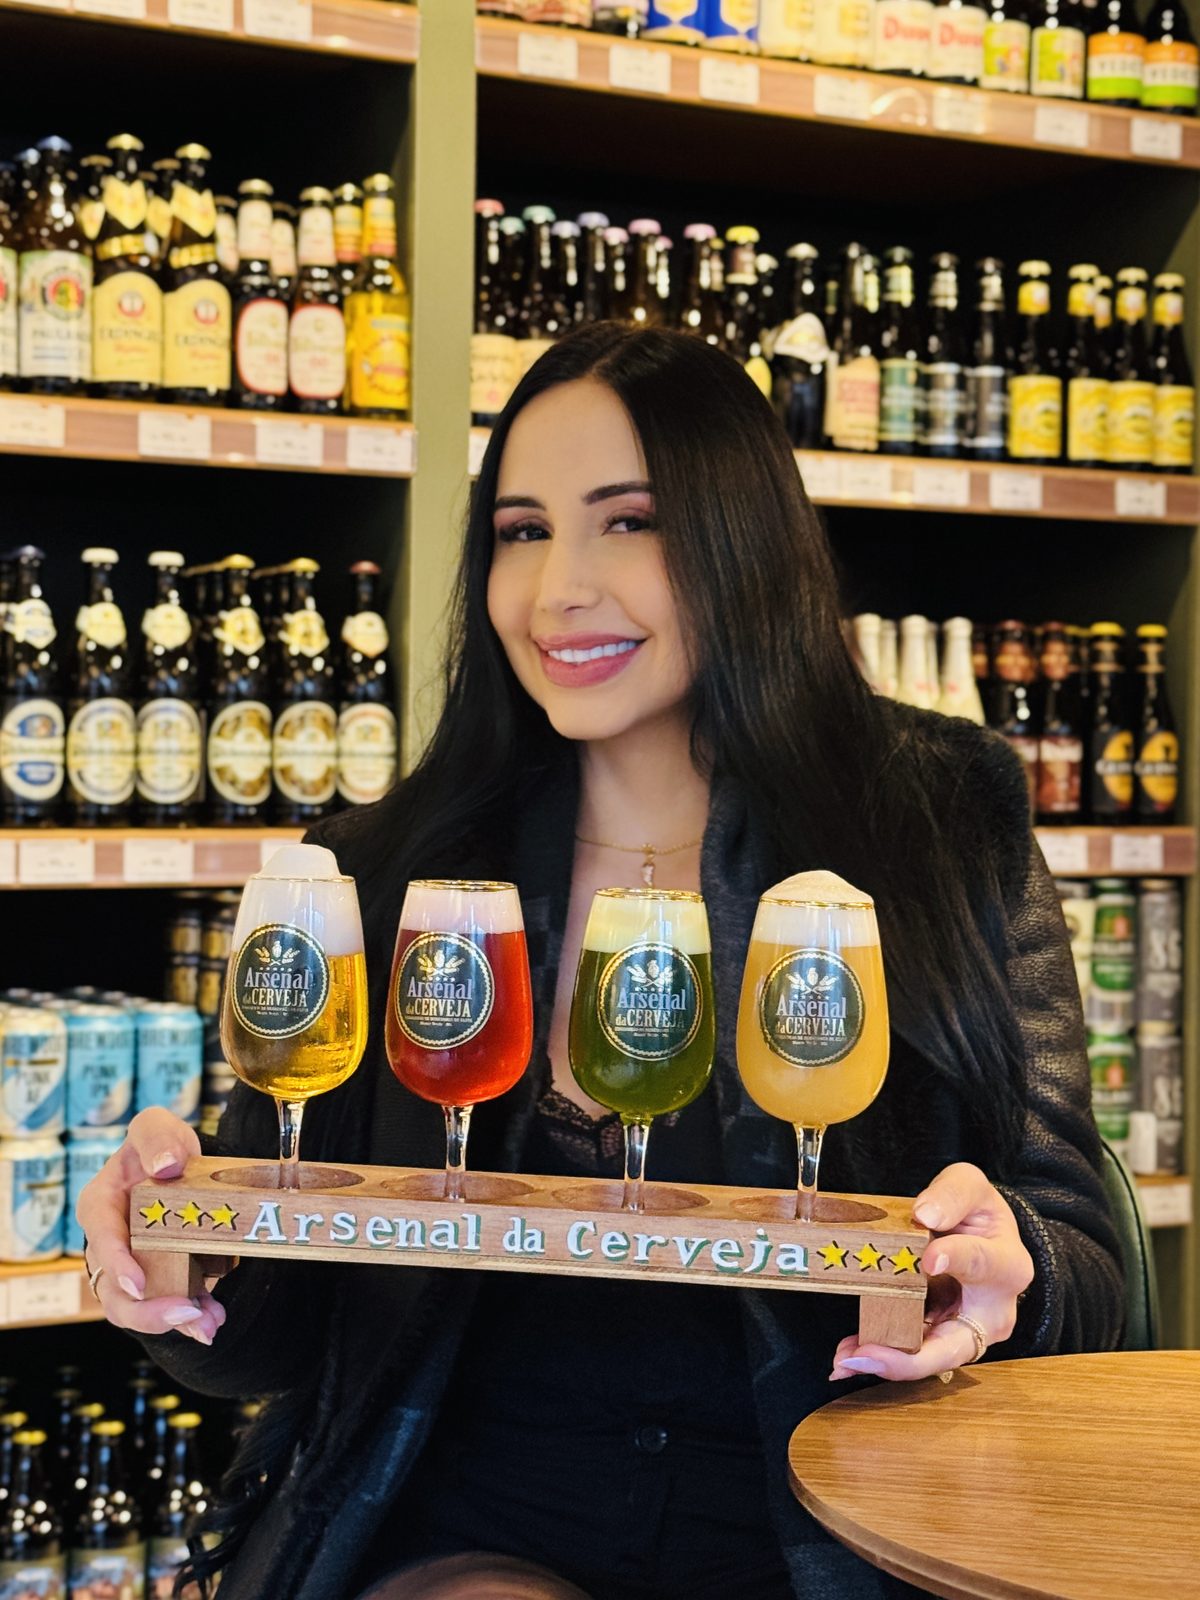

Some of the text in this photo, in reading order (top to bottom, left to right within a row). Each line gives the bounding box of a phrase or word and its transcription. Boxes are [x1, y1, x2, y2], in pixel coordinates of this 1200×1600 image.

[244, 967, 309, 990] Arsenal
[407, 976, 473, 1000] Arsenal
[252, 987, 308, 1008] CERVEJA
[414, 998, 472, 1018] CERVEJA
[617, 987, 687, 1010] Arsenal
[776, 993, 847, 1019] Arsenal
[615, 1008, 686, 1028] da CERVEJA
[785, 1016, 847, 1037] CERVEJA
[243, 1201, 809, 1276] Arsenal da Cerveja
